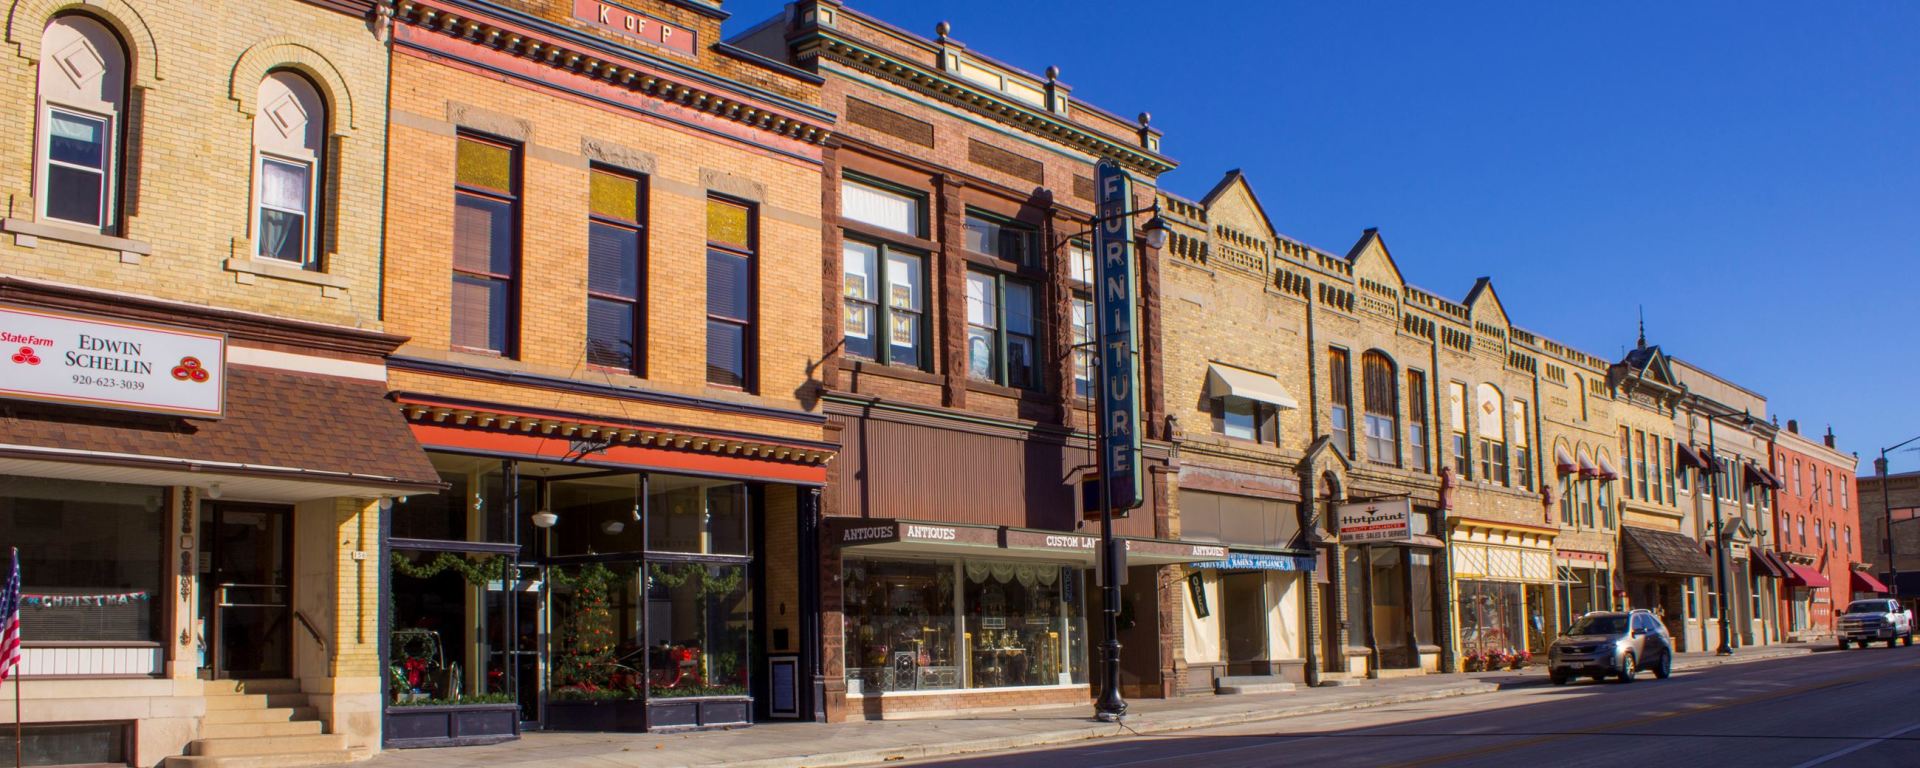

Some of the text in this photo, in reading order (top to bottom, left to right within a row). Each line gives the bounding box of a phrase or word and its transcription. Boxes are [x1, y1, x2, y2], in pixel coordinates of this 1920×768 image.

[600, 4, 672, 43] K OF P
[1104, 175, 1131, 472] FURNITURE
[79, 334, 142, 356] EDWIN
[65, 351, 152, 375] SCHELLIN
[72, 375, 145, 391] 920-623-3039
[1341, 512, 1405, 524] Hotpoint
[843, 526, 894, 541] ANTIQUES
[907, 526, 956, 540] ANTIQUES
[1046, 536, 1079, 548] CUSTOM
[1192, 546, 1224, 557] ANTIQUES
